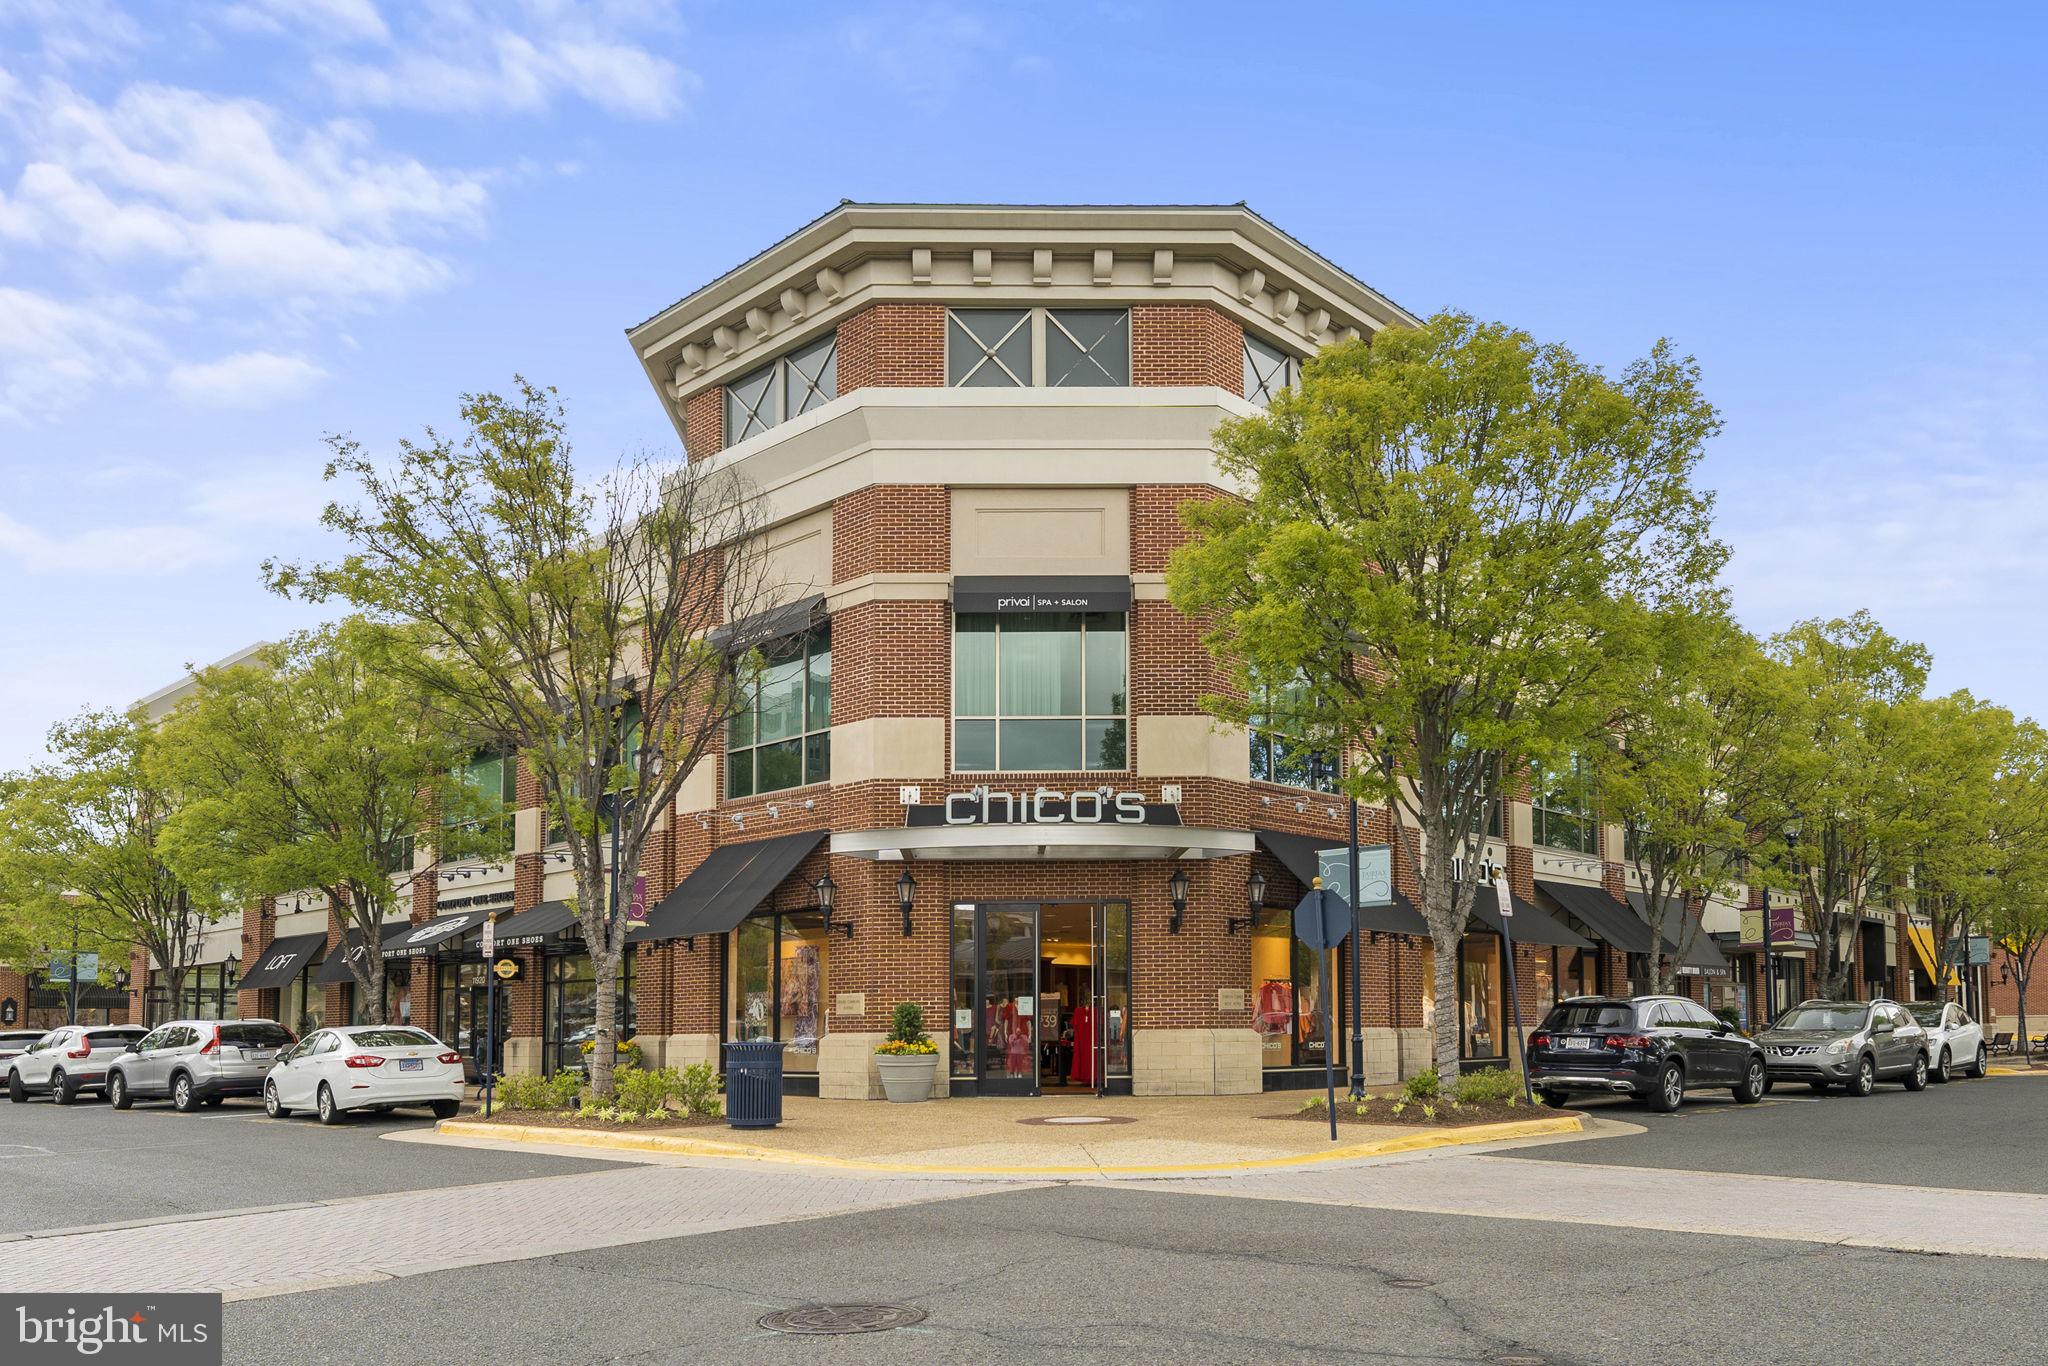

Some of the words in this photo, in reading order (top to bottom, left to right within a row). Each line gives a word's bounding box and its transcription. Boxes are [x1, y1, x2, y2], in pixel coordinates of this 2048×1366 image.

[998, 596, 1030, 611] privai
[945, 785, 1146, 825] chico's
[475, 939, 504, 949] COORT
[506, 937, 520, 946] ONE
[521, 935, 544, 945] SHOES
[396, 947, 407, 957] ONE
[408, 946, 427, 955] SHOES
[264, 953, 298, 971] LOFT
